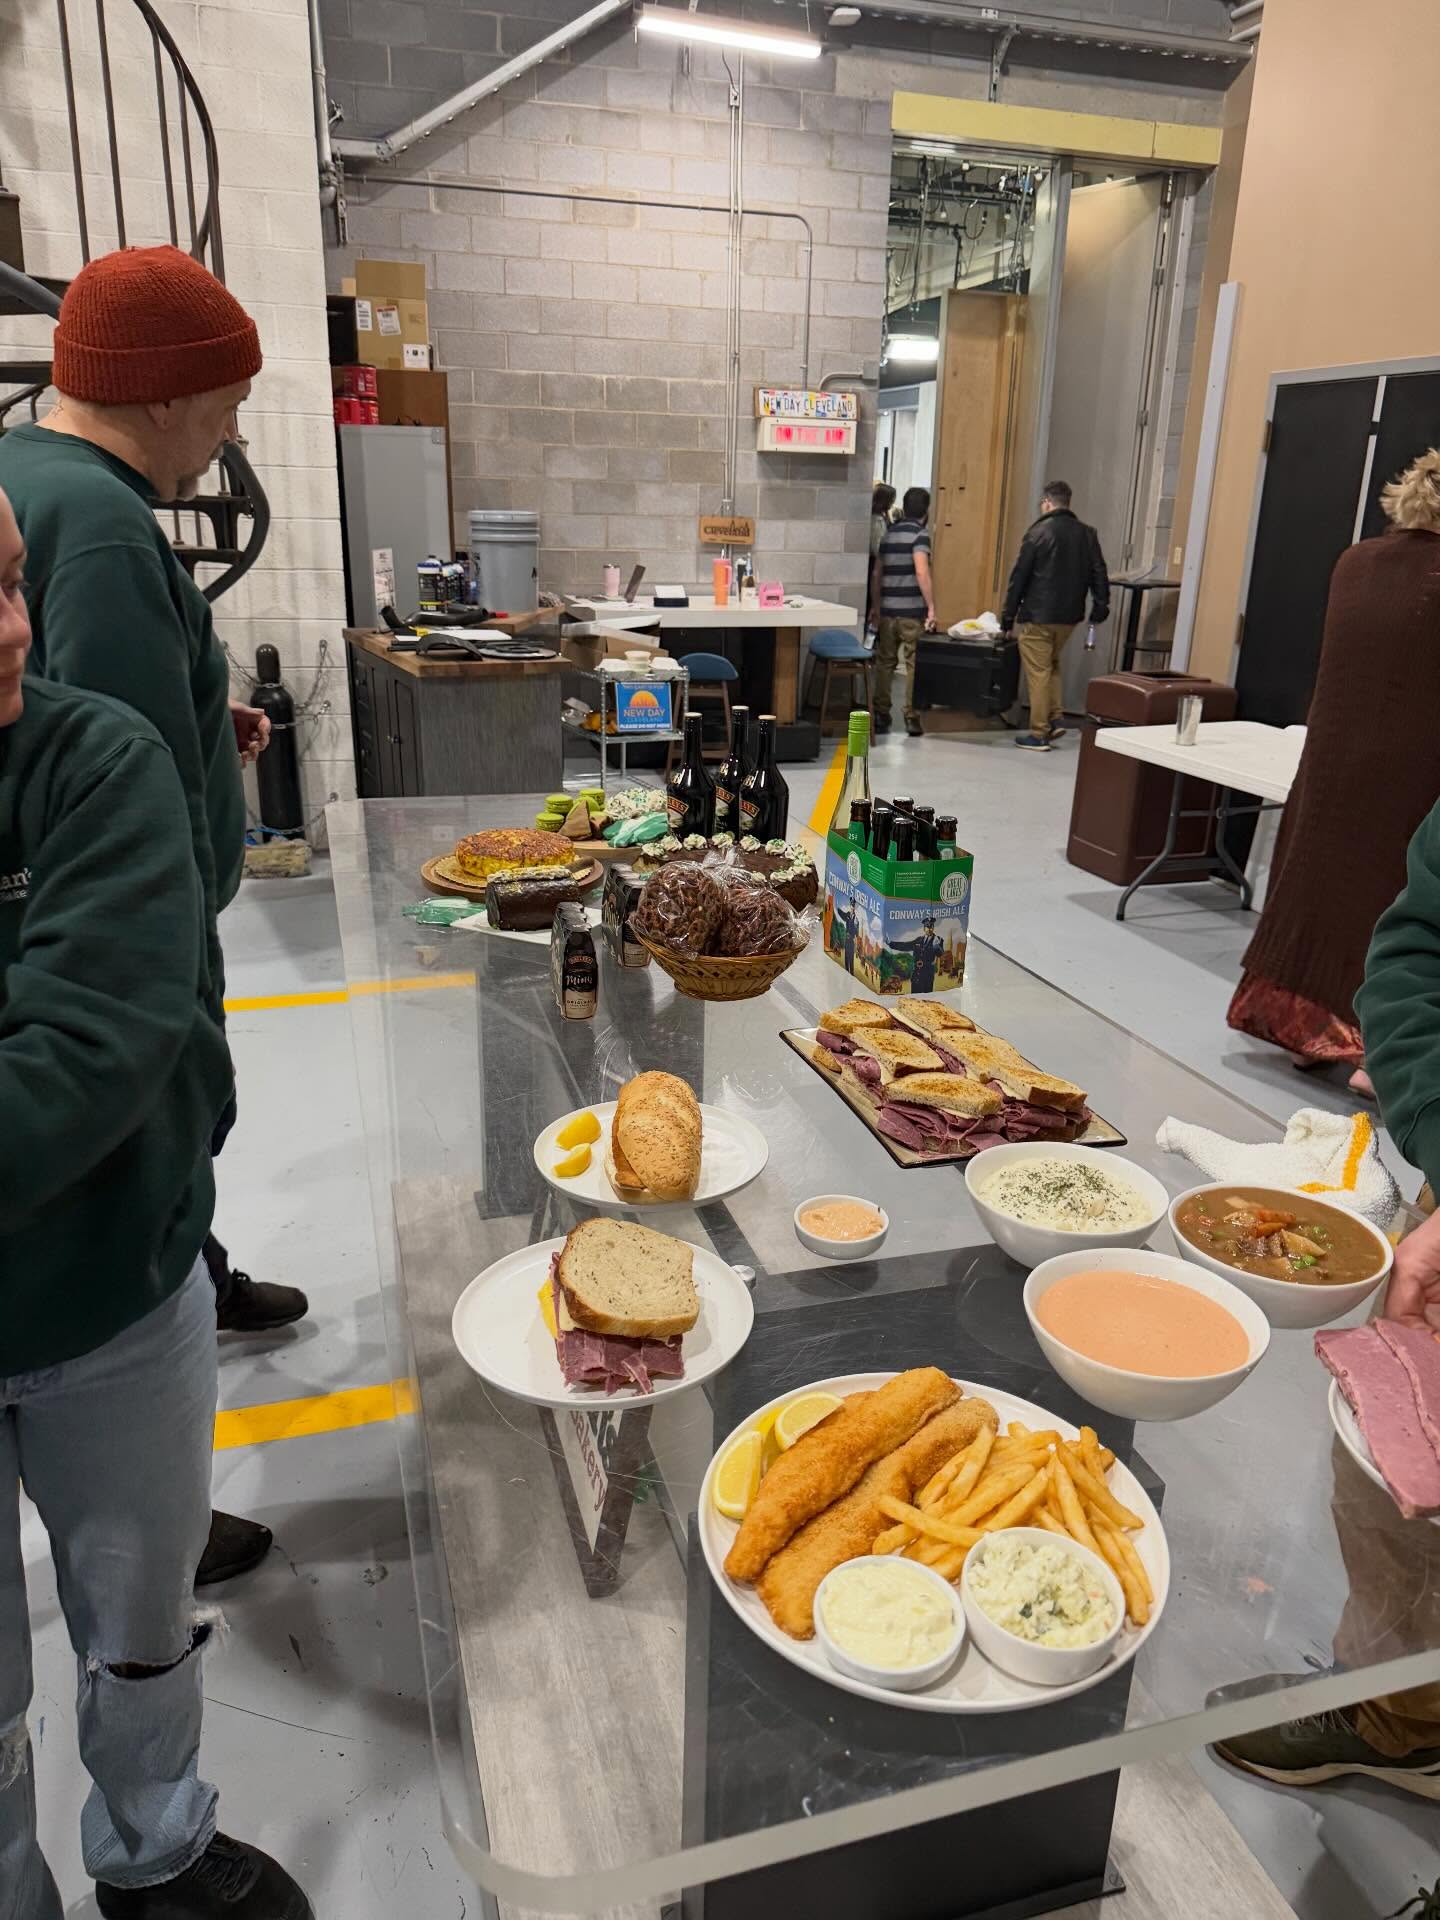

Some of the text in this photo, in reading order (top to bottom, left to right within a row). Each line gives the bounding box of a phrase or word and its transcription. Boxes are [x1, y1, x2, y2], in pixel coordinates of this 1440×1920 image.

[763, 396, 853, 417] NEW DAY CLEVELAND
[623, 708, 666, 717] NEW DAY
[947, 878, 963, 888] GREAT
[829, 871, 854, 898] CONWAY'S
[854, 889, 869, 909] IRISH
[868, 898, 881, 916] ALE
[946, 888, 962, 898] LAKES
[889, 905, 966, 920] CONWAY'S IRISH ALE
